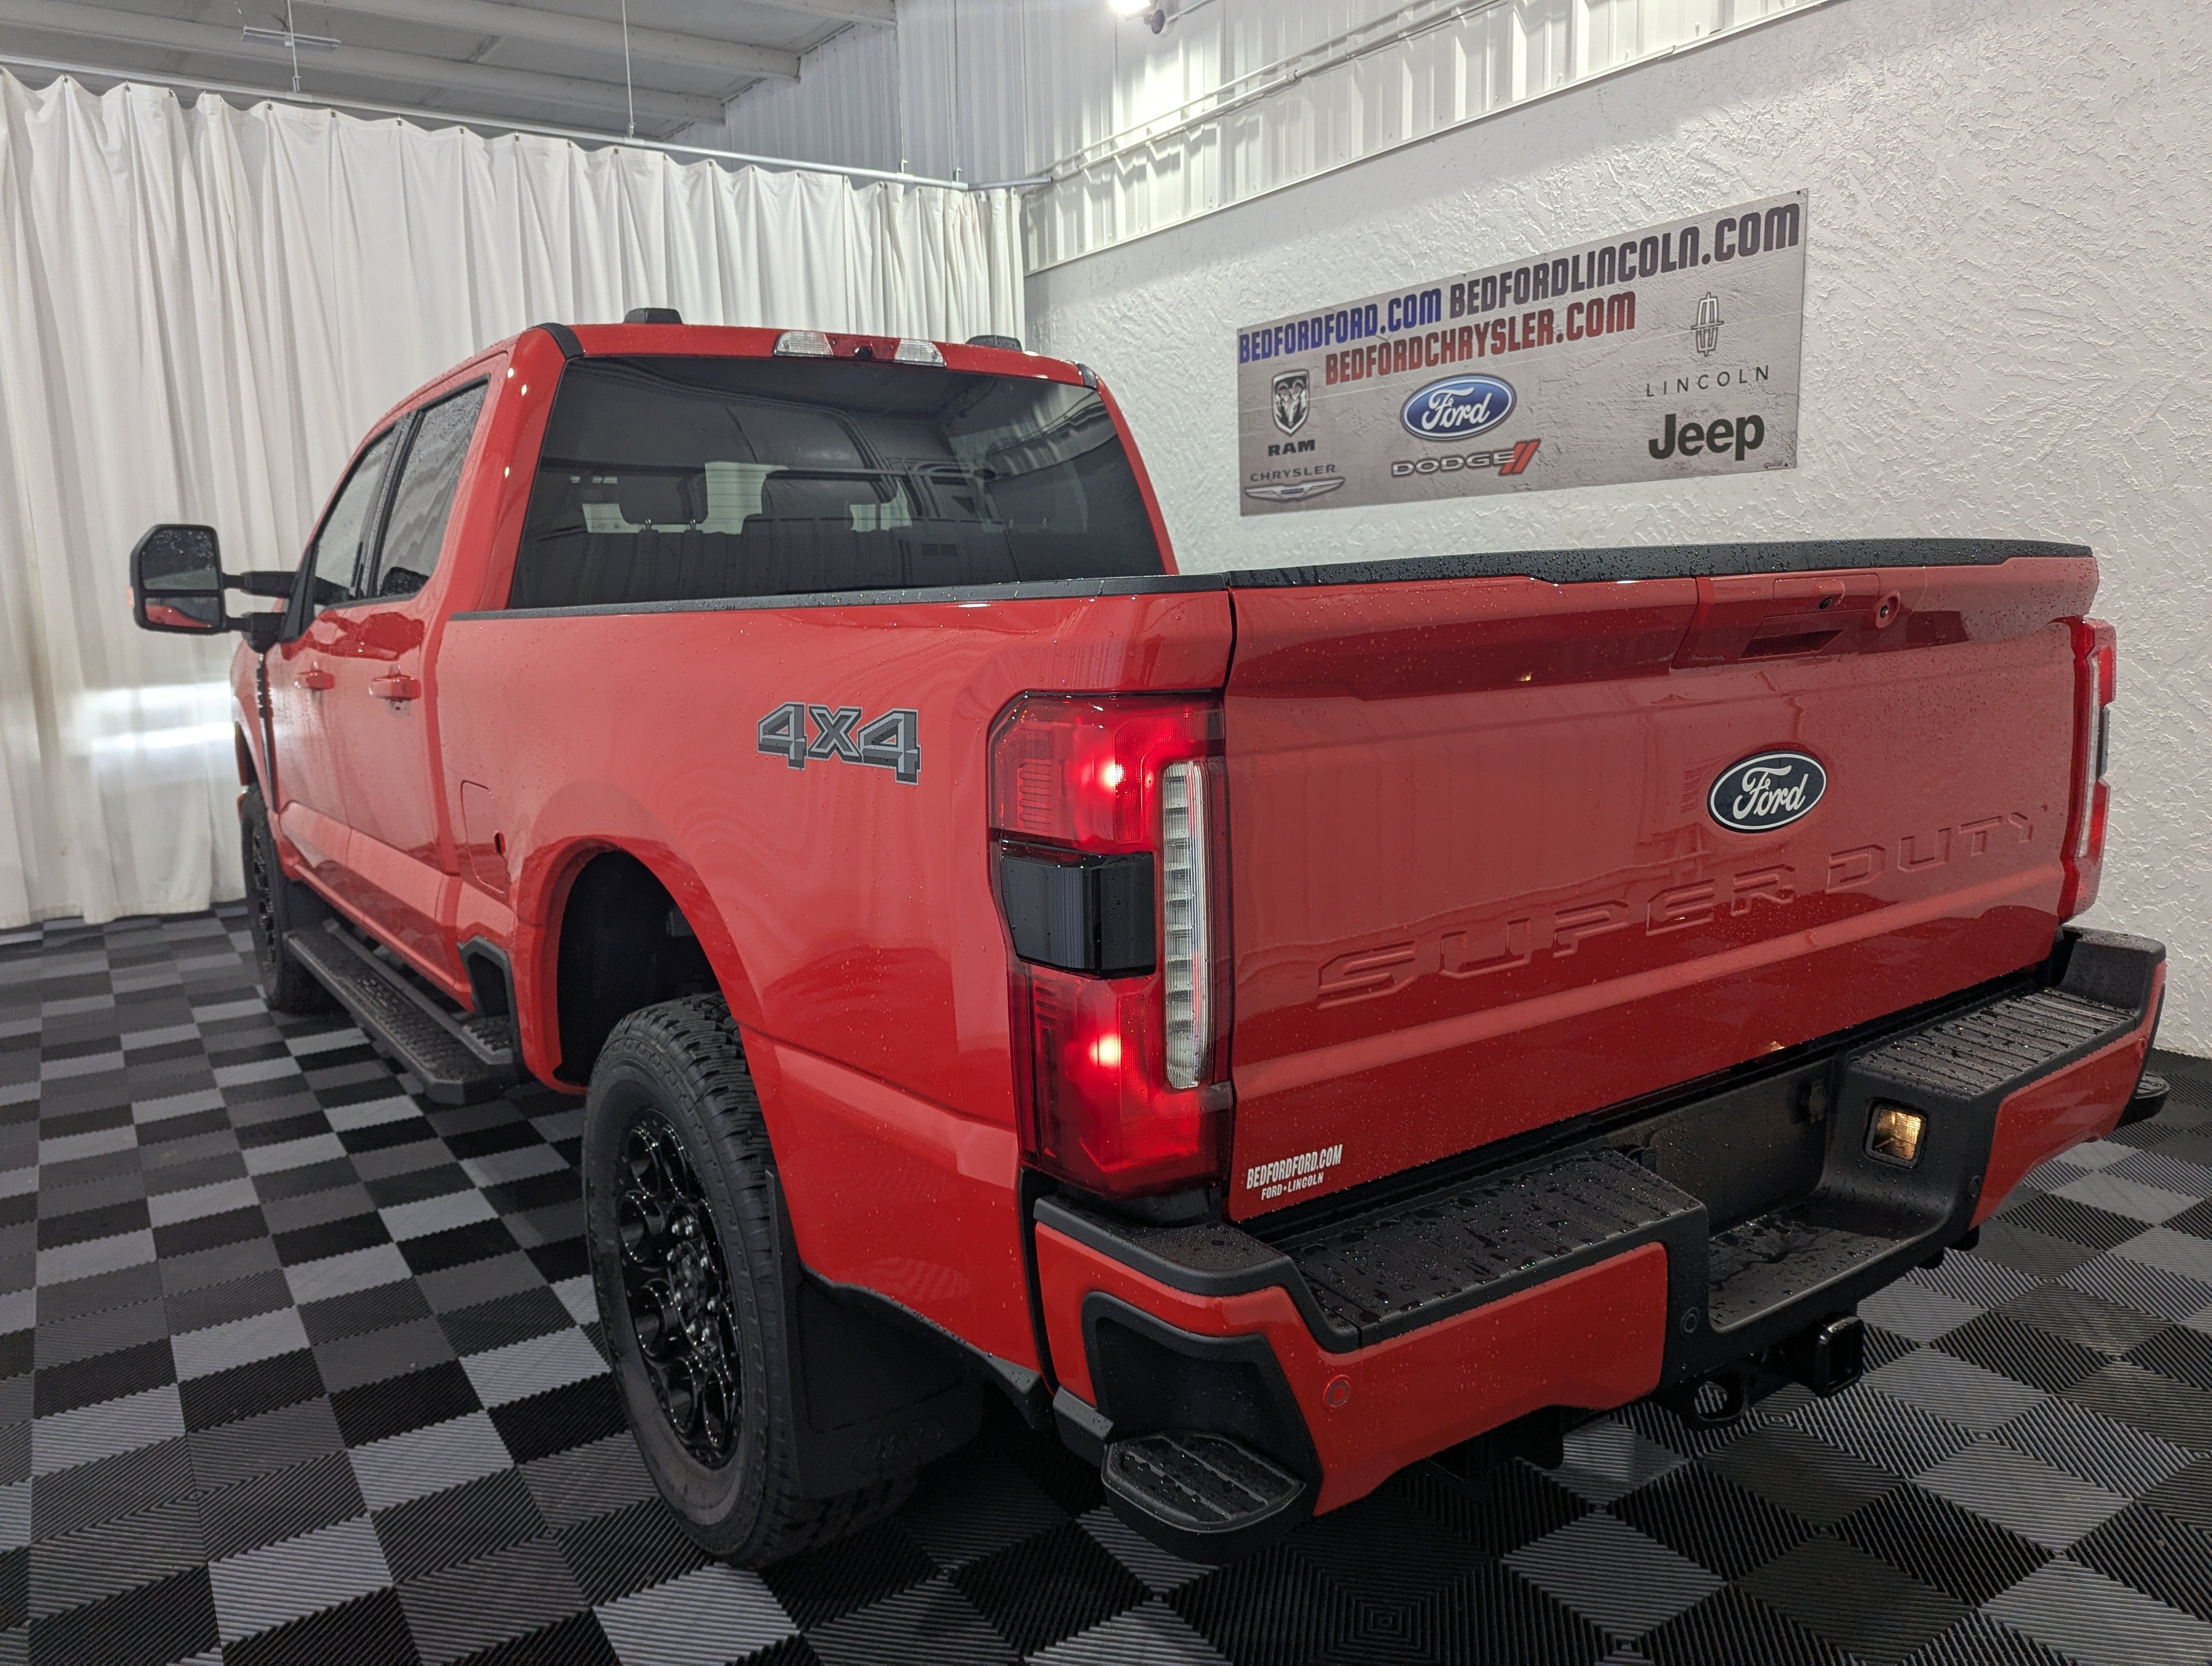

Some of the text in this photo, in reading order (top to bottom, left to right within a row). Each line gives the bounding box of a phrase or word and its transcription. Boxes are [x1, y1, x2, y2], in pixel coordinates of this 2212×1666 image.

[1239, 202, 1801, 364] BEDFORDFORD.COM BEDFORDLINCOLN.COM
[1326, 291, 1636, 386] BEDFORDCHRYSLER.COM
[1646, 365, 1769, 398] LINCOLN
[1421, 386, 1493, 430] Ford
[1268, 439, 1316, 457] RAM
[1648, 413, 1765, 462] Jeep
[1250, 464, 1336, 482] CHRYSLER
[1391, 451, 1516, 478] DODGE
[1733, 765, 1809, 819] Ford
[1316, 804, 2048, 1010] SUPER DUTY
[1246, 1144, 1343, 1189] BEDFORDFORD.COM
